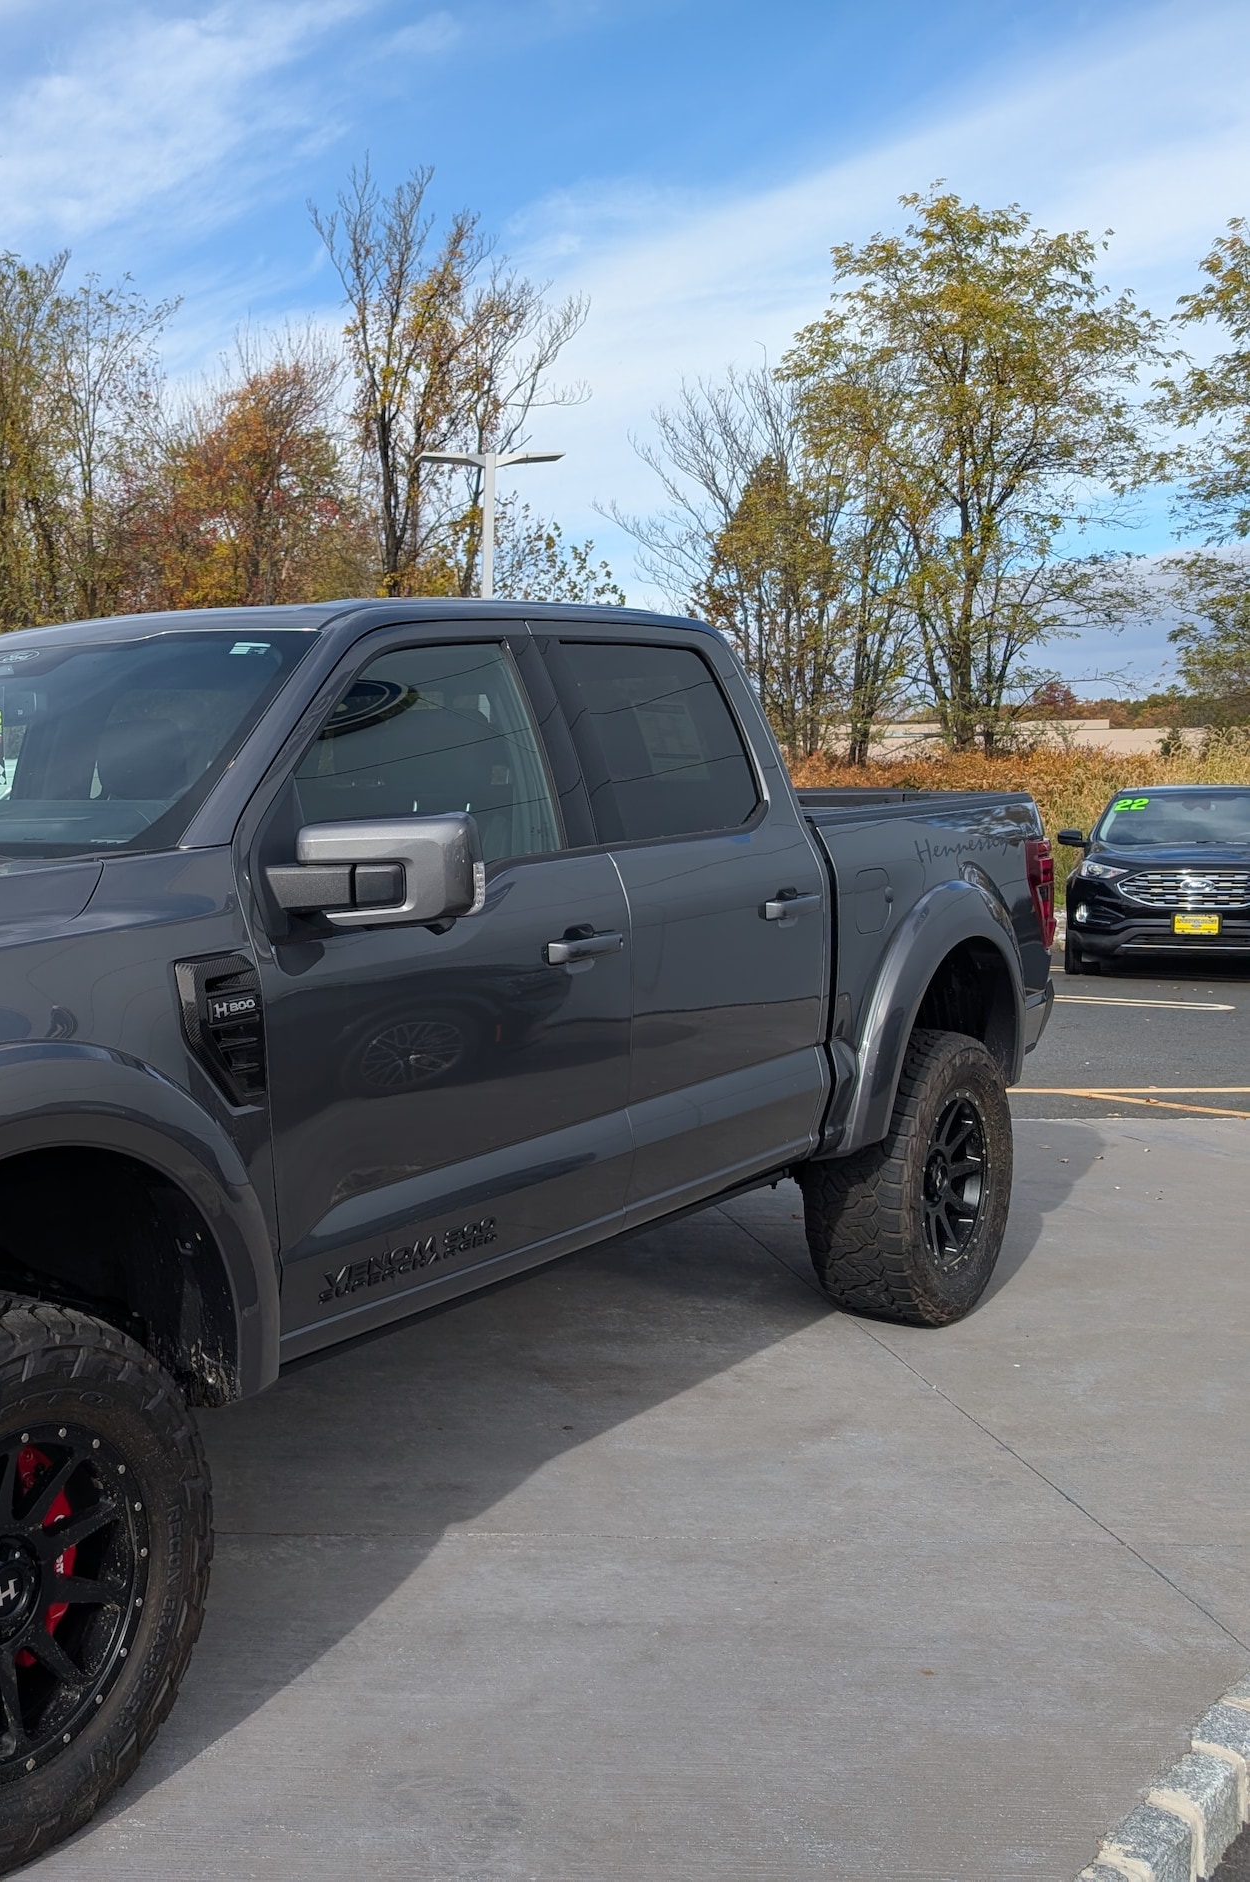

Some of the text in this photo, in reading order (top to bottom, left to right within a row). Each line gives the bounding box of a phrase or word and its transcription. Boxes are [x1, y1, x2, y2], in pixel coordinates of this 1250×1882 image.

[1113, 797, 1150, 812] 22
[323, 1216, 497, 1290] VENOM 800
